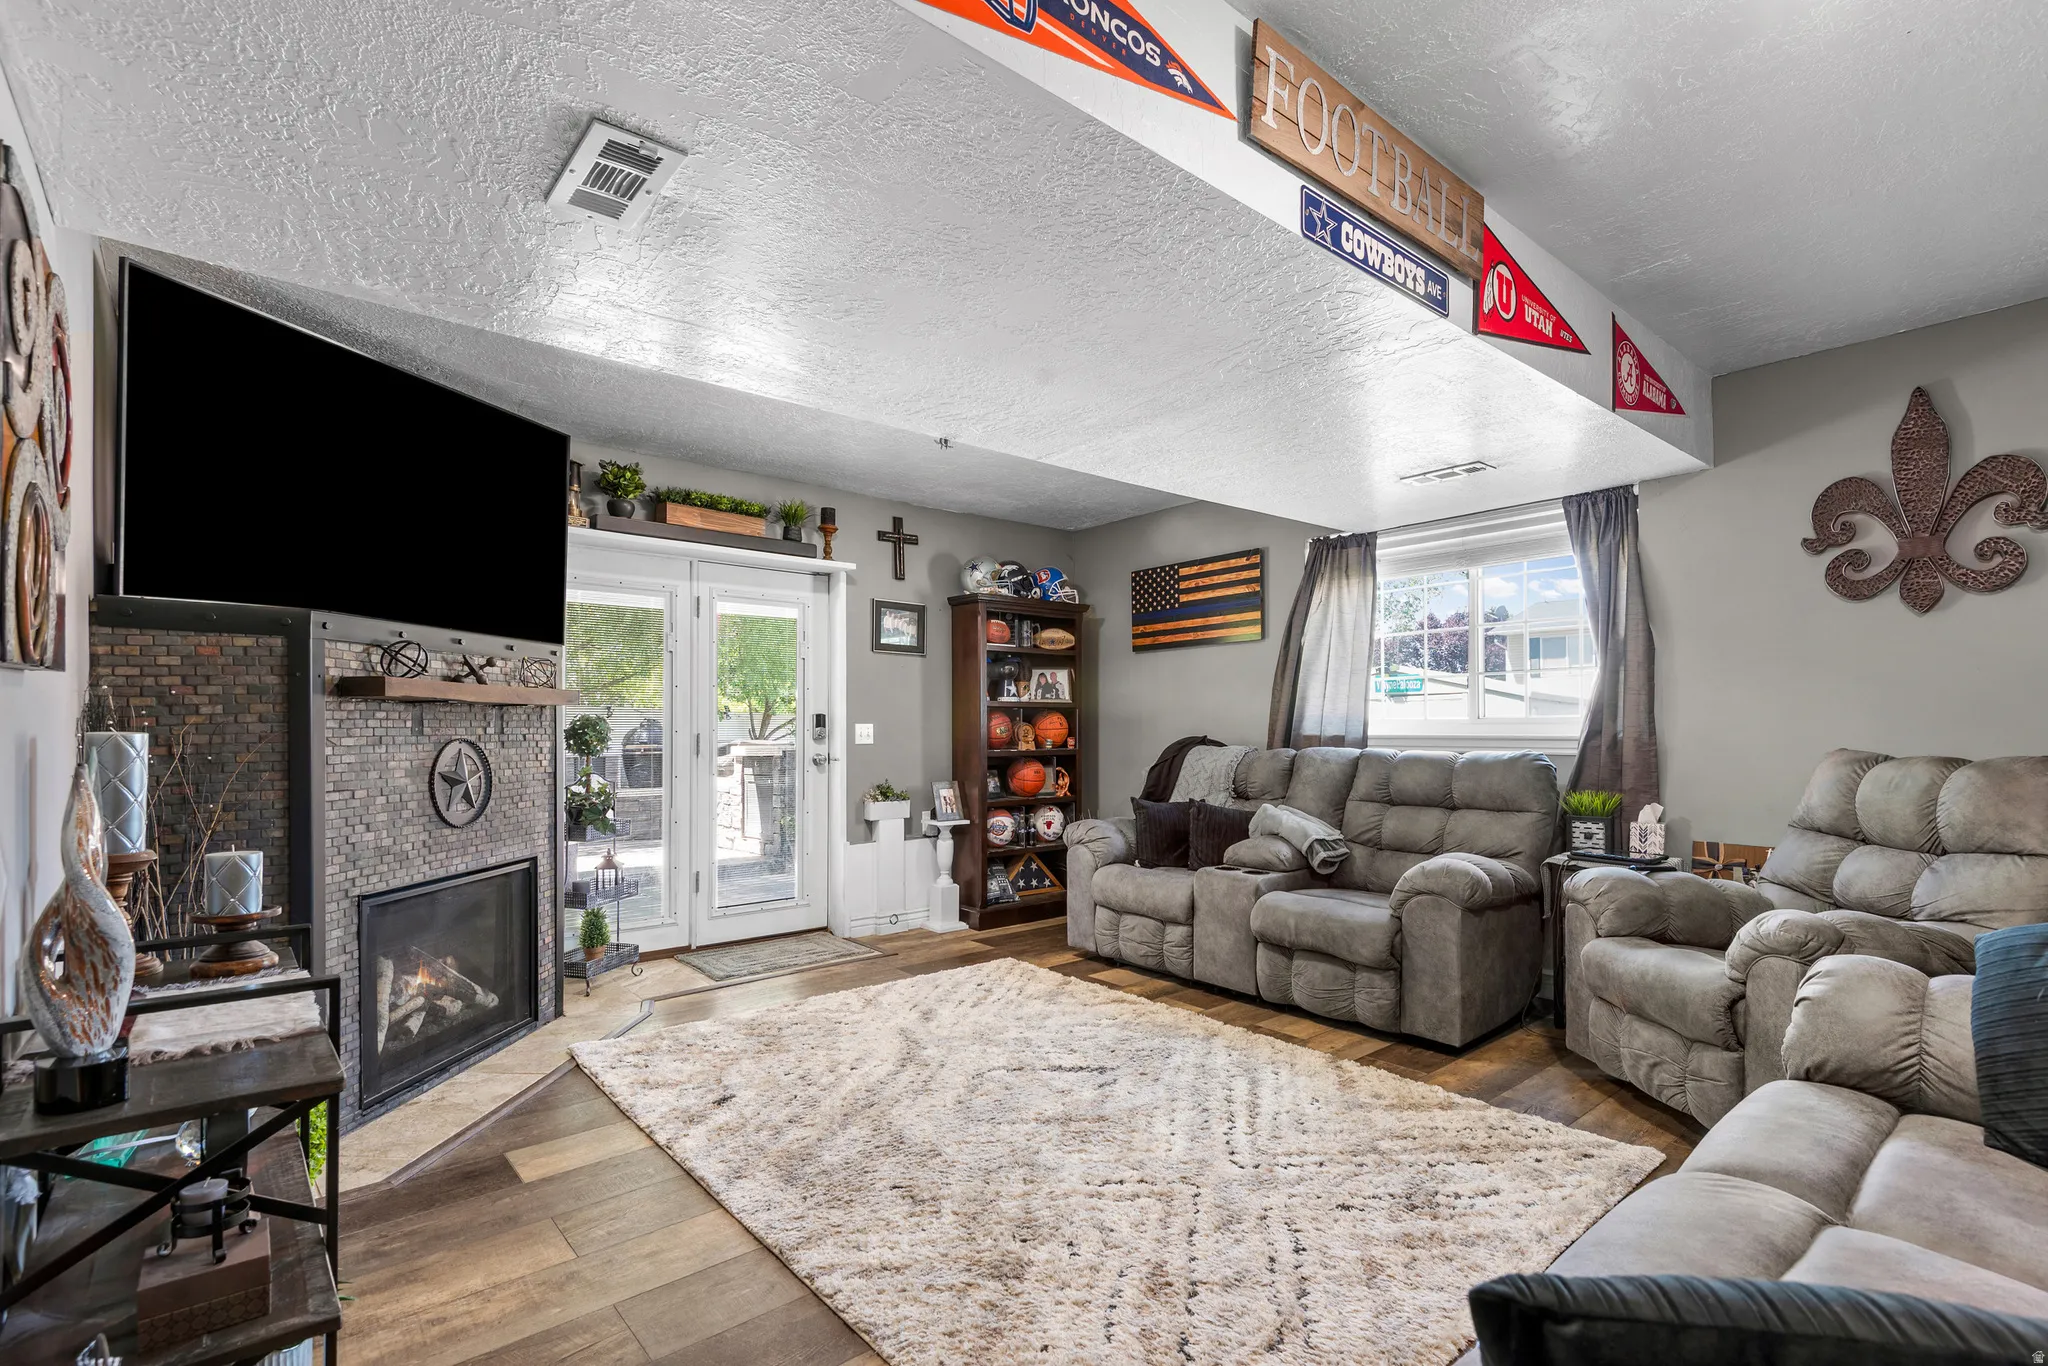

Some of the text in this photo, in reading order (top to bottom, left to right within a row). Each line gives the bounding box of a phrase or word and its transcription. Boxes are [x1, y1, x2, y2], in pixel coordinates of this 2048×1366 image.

[1062, 0, 1161, 66] ONCOS
[1069, 13, 1127, 56] DENVER
[1261, 45, 1479, 261] FOOTBALL
[1341, 221, 1442, 300] COWBOYS AVE
[1521, 294, 1557, 323] UNIVERSITY OF
[1524, 303, 1553, 338] UTAH
[1560, 329, 1572, 343] UTES
[1642, 380, 1667, 410] ALABAMA
